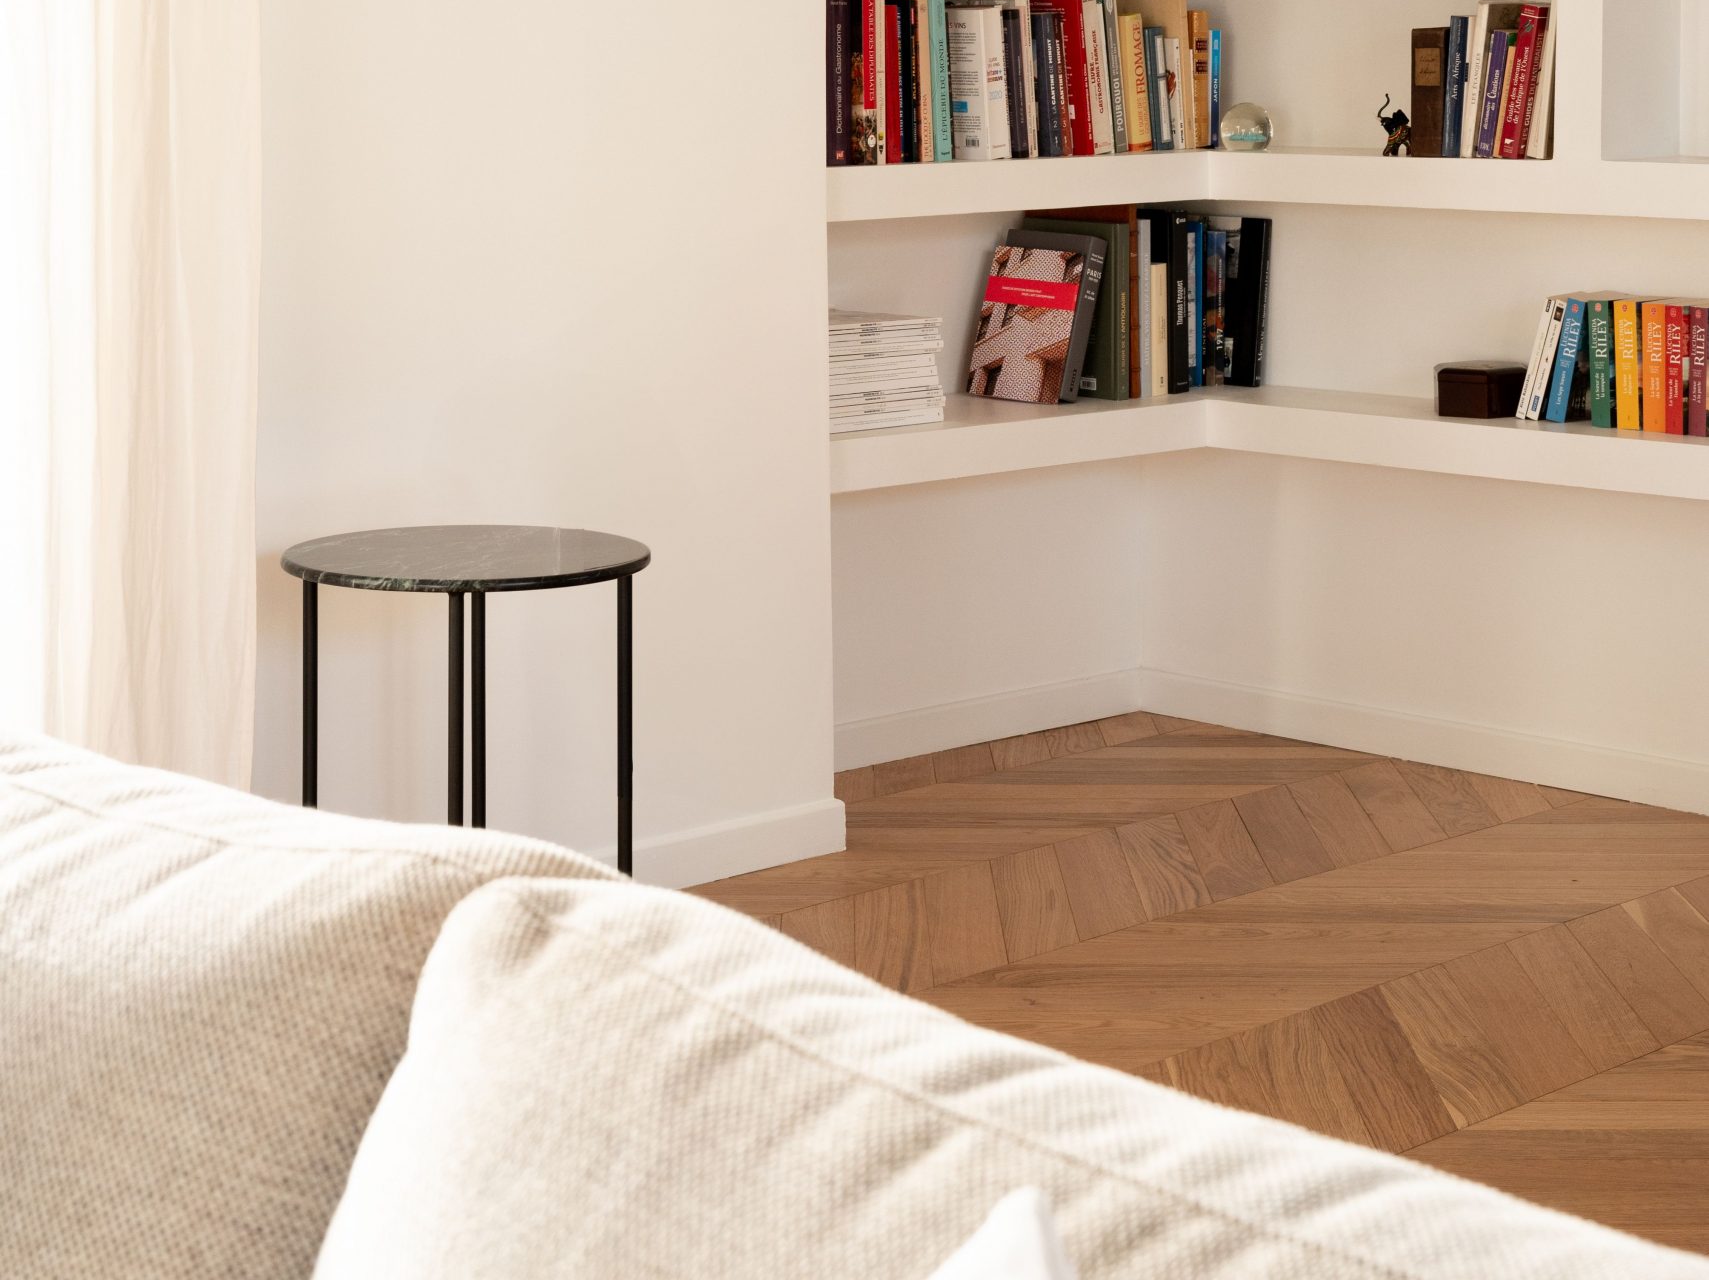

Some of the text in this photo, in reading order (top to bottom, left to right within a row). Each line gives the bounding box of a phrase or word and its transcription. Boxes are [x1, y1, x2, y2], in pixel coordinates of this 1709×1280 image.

[1132, 22, 1146, 94] FROMAGE
[1451, 52, 1461, 99] Arts Afrique
[1113, 77, 1124, 132] POURQUOI
[1486, 69, 1500, 99] Citations
[1506, 101, 1515, 123] Guide
[1512, 58, 1521, 86] oiseaux
[1513, 84, 1524, 114] l'Afrique
[835, 86, 843, 134] Dictionnaire
[939, 91, 948, 141] L'ÉPICERIE
[1524, 97, 1534, 126] GUIDES
[1560, 318, 1572, 347] LUCINDA
[1563, 318, 1580, 358] RILEY
[1595, 318, 1607, 358] RILEY
[1623, 319, 1634, 359] RILEY
[1651, 321, 1662, 362] RILEY
[1670, 323, 1681, 364] RILEY
[1695, 325, 1705, 366] RILEY
